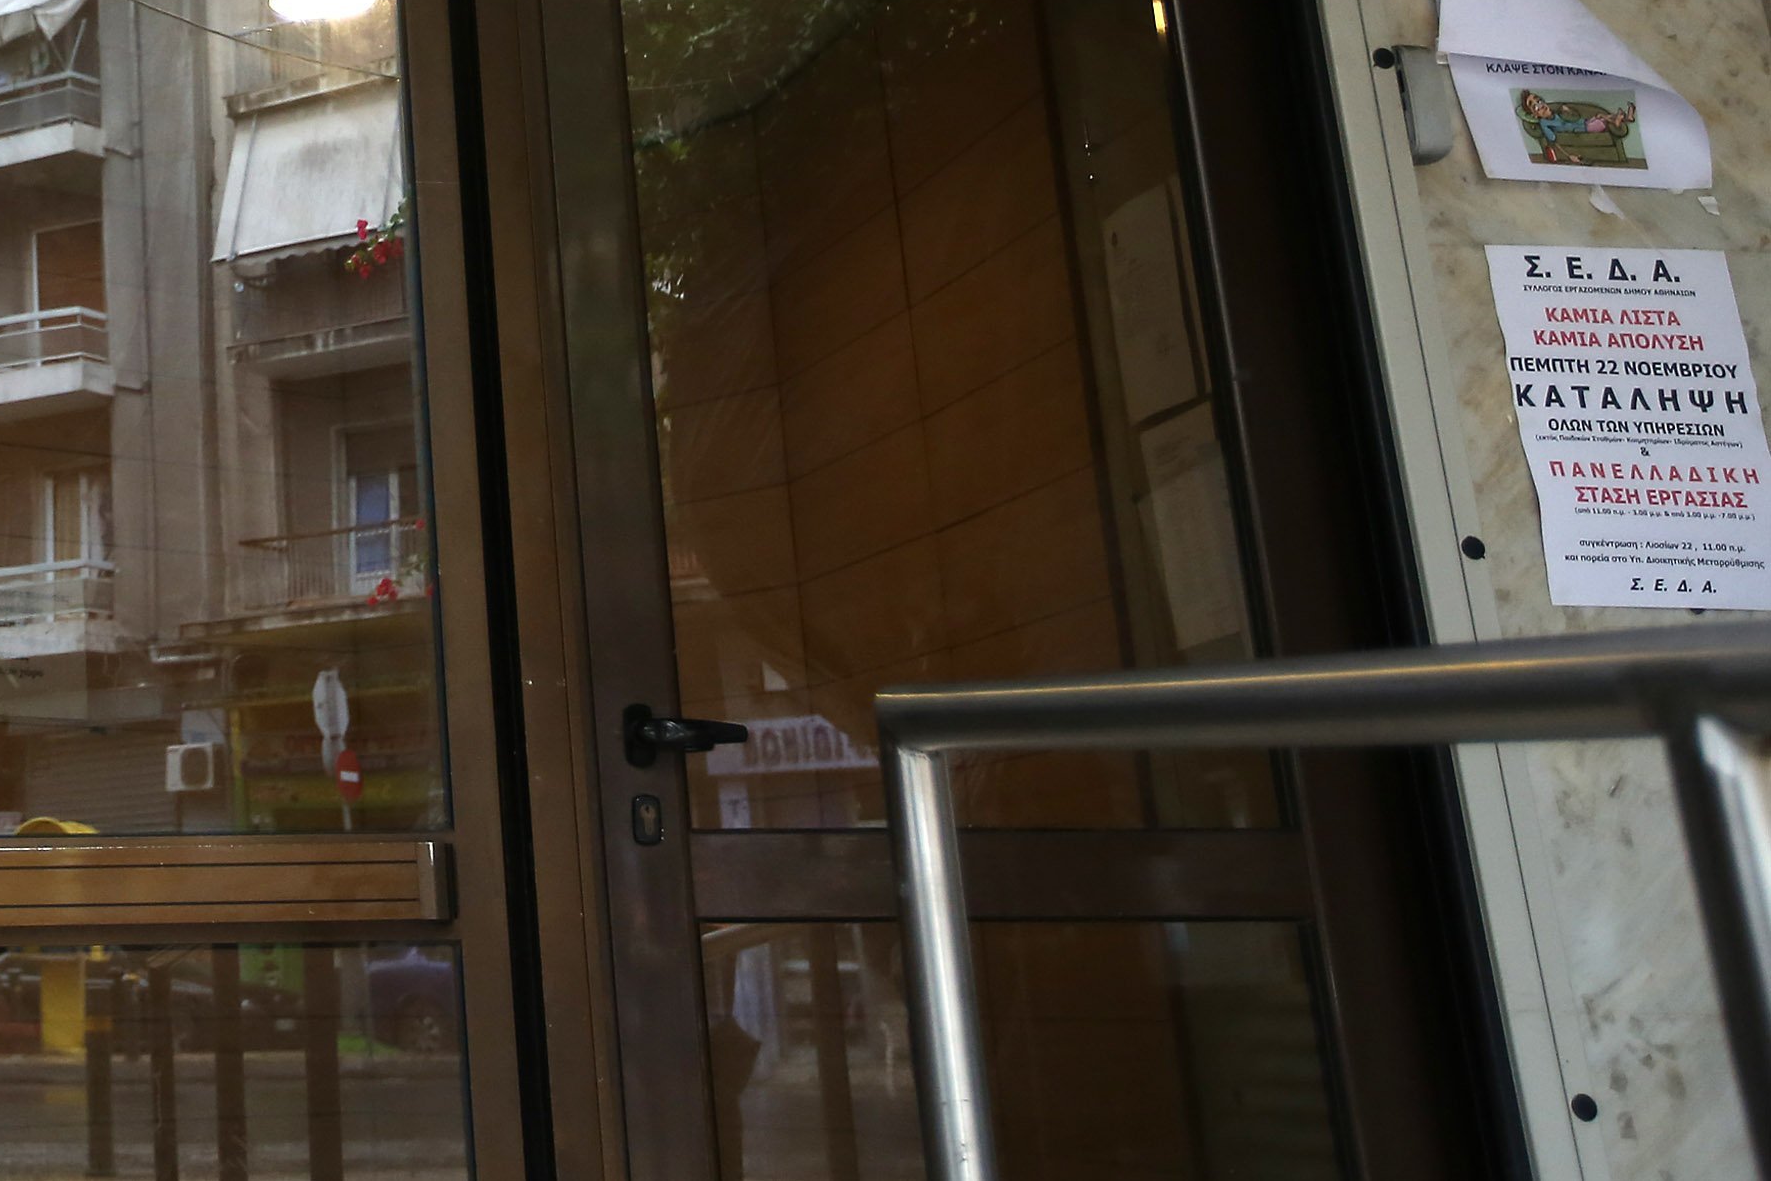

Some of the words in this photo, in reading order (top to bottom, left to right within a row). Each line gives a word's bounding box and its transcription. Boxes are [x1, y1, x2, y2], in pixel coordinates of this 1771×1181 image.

[1486, 63, 1530, 74] ΚΛΑΨΕ
[1532, 64, 1564, 75] ΣΤΟΝ
[1545, 306, 1613, 324] ΚΑΜΙΑ
[1619, 309, 1681, 326] ΛΙΣΤΑ
[1533, 330, 1601, 347] ΚΑΜΙΑ
[1607, 332, 1704, 351] ΑΠΟΛΥΣΗ
[1510, 356, 1590, 374] ΠΕΜΠΤΗ
[1596, 360, 1619, 375] 22
[1624, 361, 1738, 379] ΝΟΕΜΒΡΙΟΥ
[1515, 384, 1748, 414] ΚΑΤΑΛΗΨΗ
[1548, 418, 1593, 432] ΟΛΩΝ
[1597, 420, 1629, 433] ΤΩΝ
[1633, 421, 1725, 436] ΥΠΗΡΕΣΙΩΝ
[1640, 447, 1650, 456] &
[1549, 461, 1760, 484] ΠΑΝΕΛΛΑΔΙΚΗ
[1575, 486, 1640, 505] ΣΤΑΣΗ
[1646, 489, 1748, 508] ΕΡΓΑΣΙΑΣ
